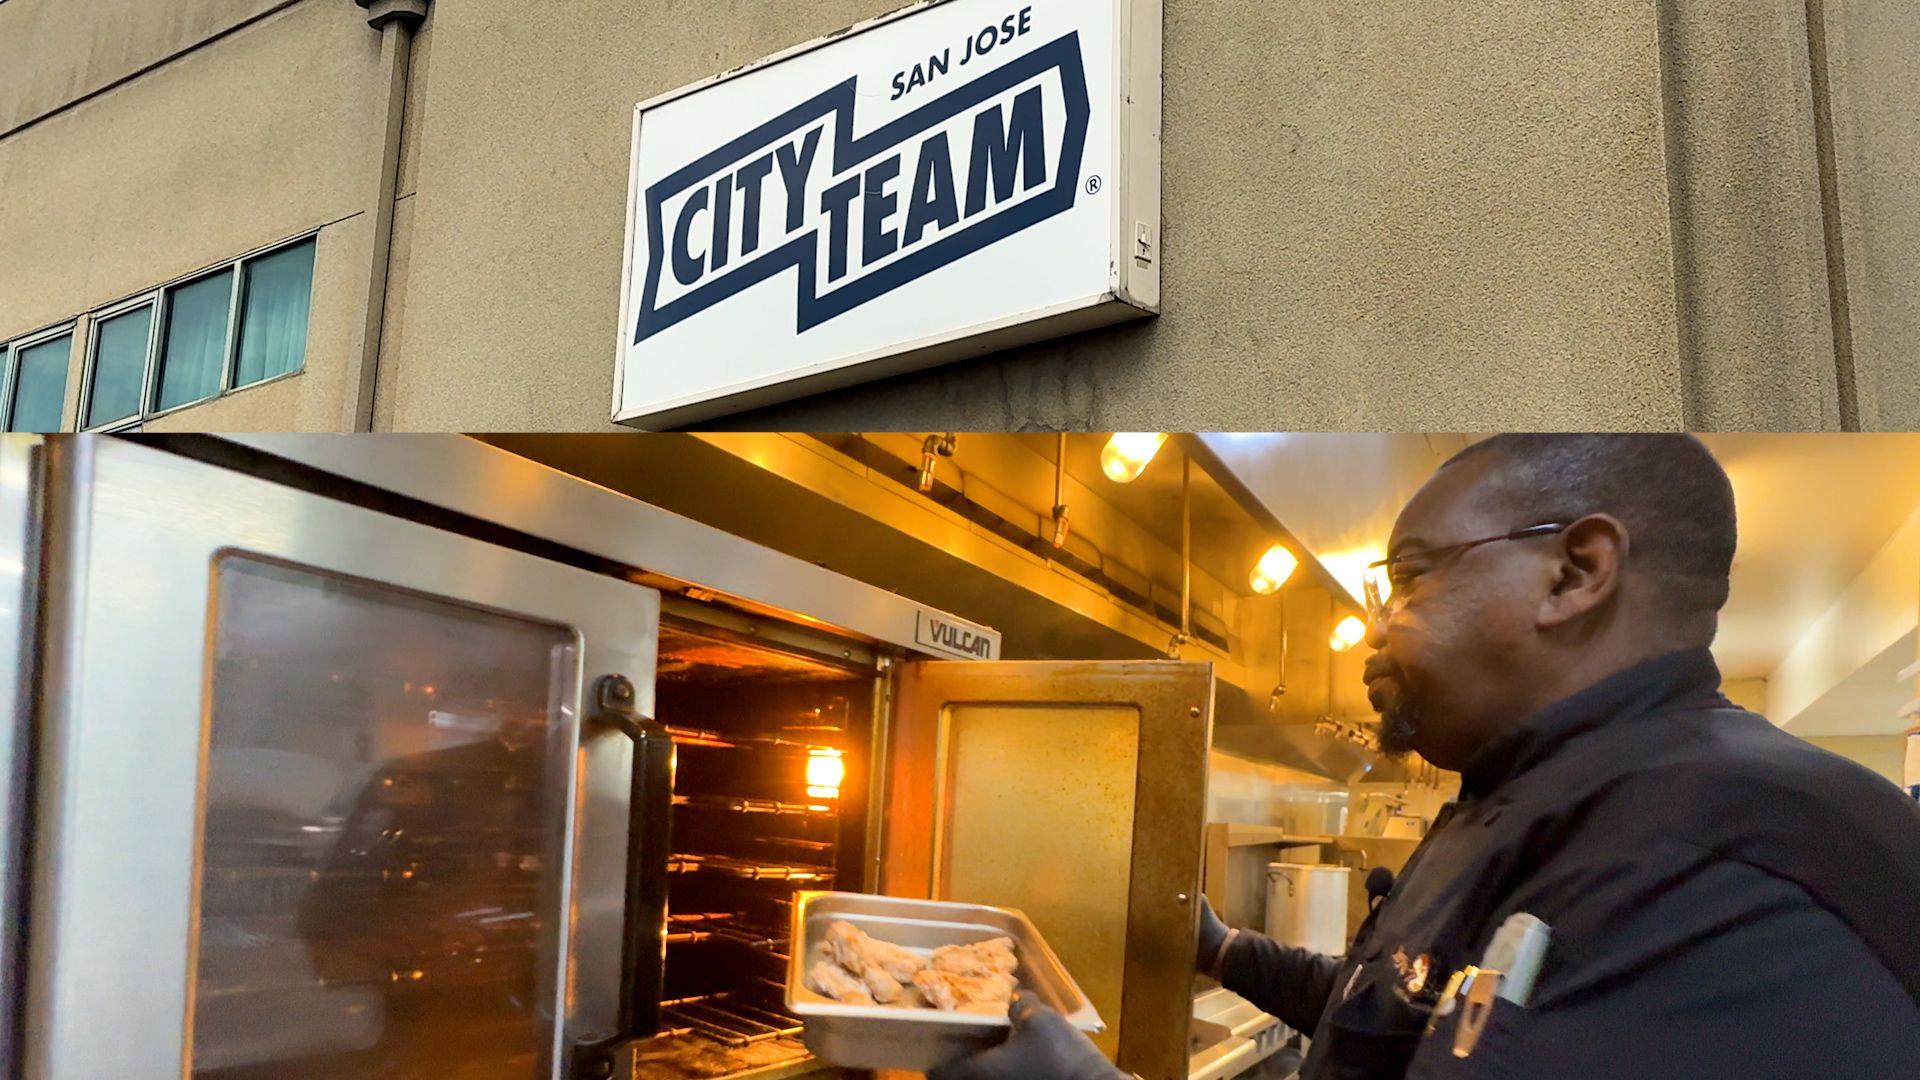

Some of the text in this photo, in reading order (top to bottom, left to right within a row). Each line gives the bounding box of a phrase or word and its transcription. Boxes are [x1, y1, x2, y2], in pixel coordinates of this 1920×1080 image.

[890, 5, 1032, 101] SAN JOSE
[671, 124, 824, 286] CITY
[820, 84, 1046, 284] TEAM
[930, 618, 991, 660] VULCAN
